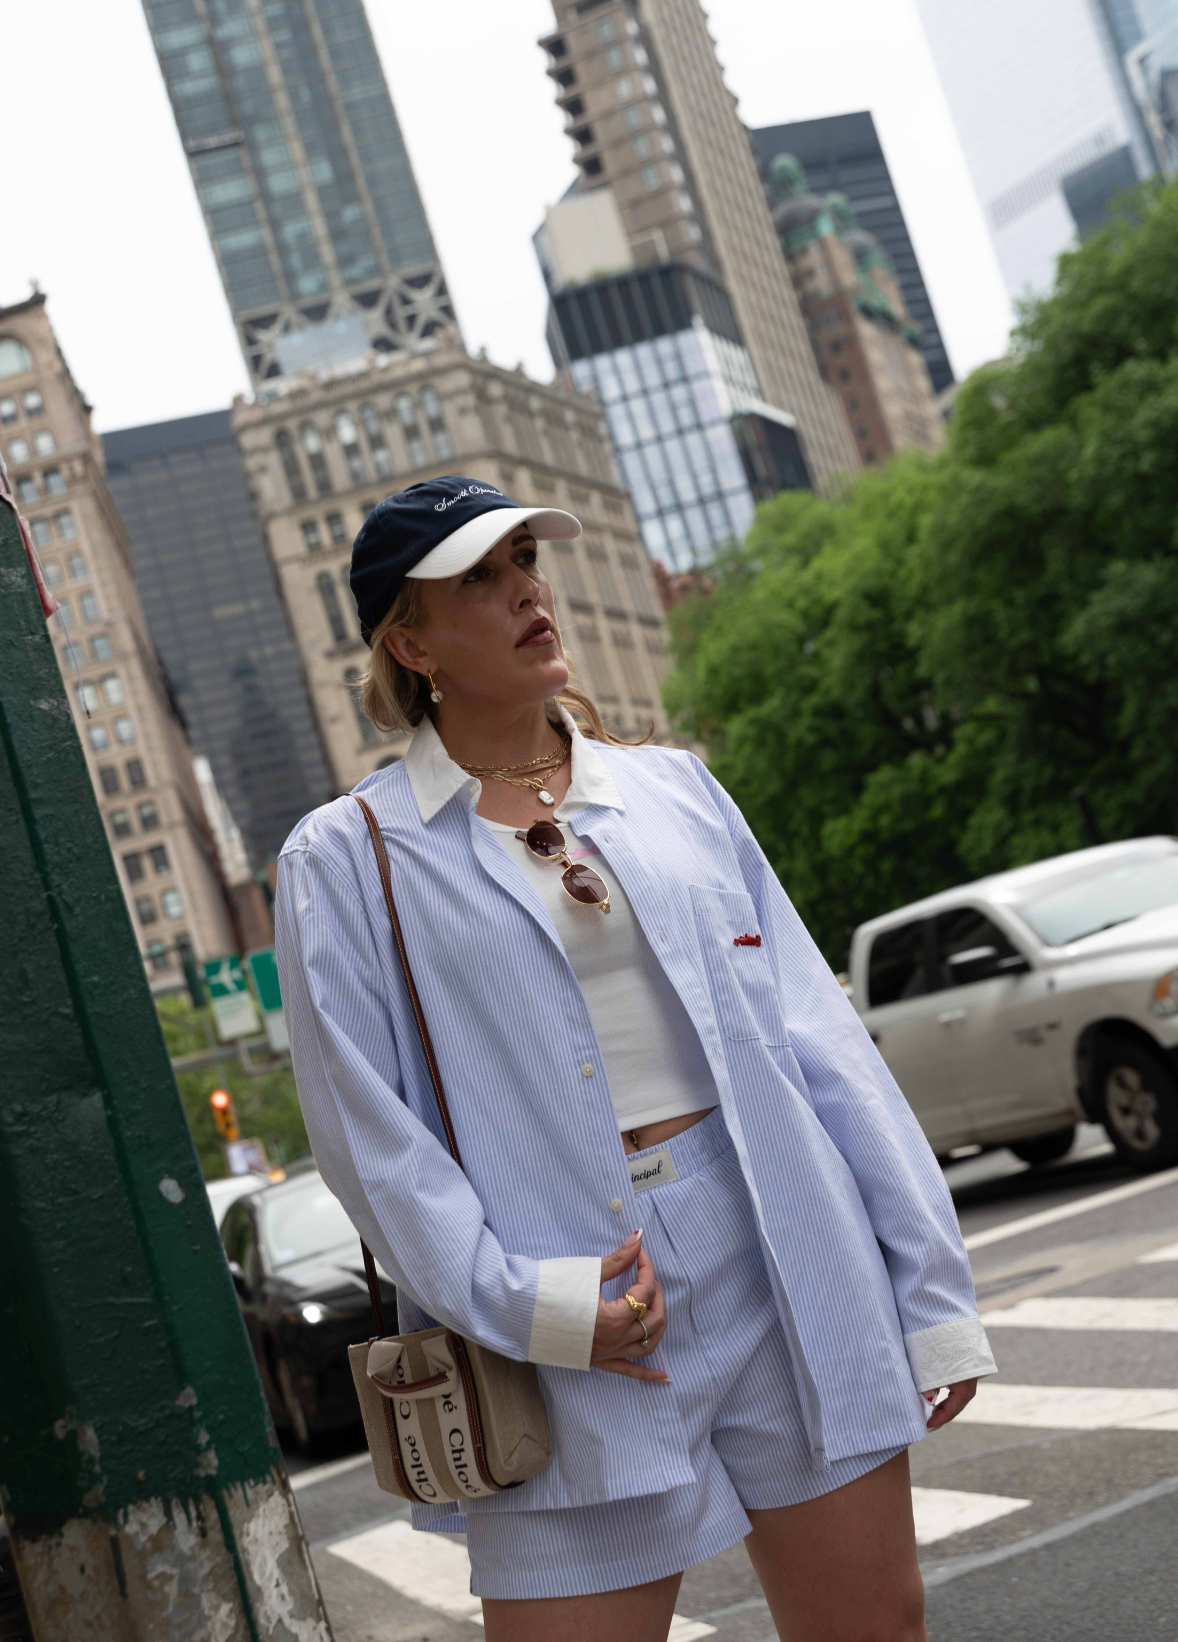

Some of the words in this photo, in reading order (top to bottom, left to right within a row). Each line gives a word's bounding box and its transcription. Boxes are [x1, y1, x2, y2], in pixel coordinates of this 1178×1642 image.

[434, 489, 469, 512] Smooth
[631, 1160, 663, 1183] incipal
[405, 1435, 437, 1498] Chloé
[449, 1428, 481, 1493] Chloé
